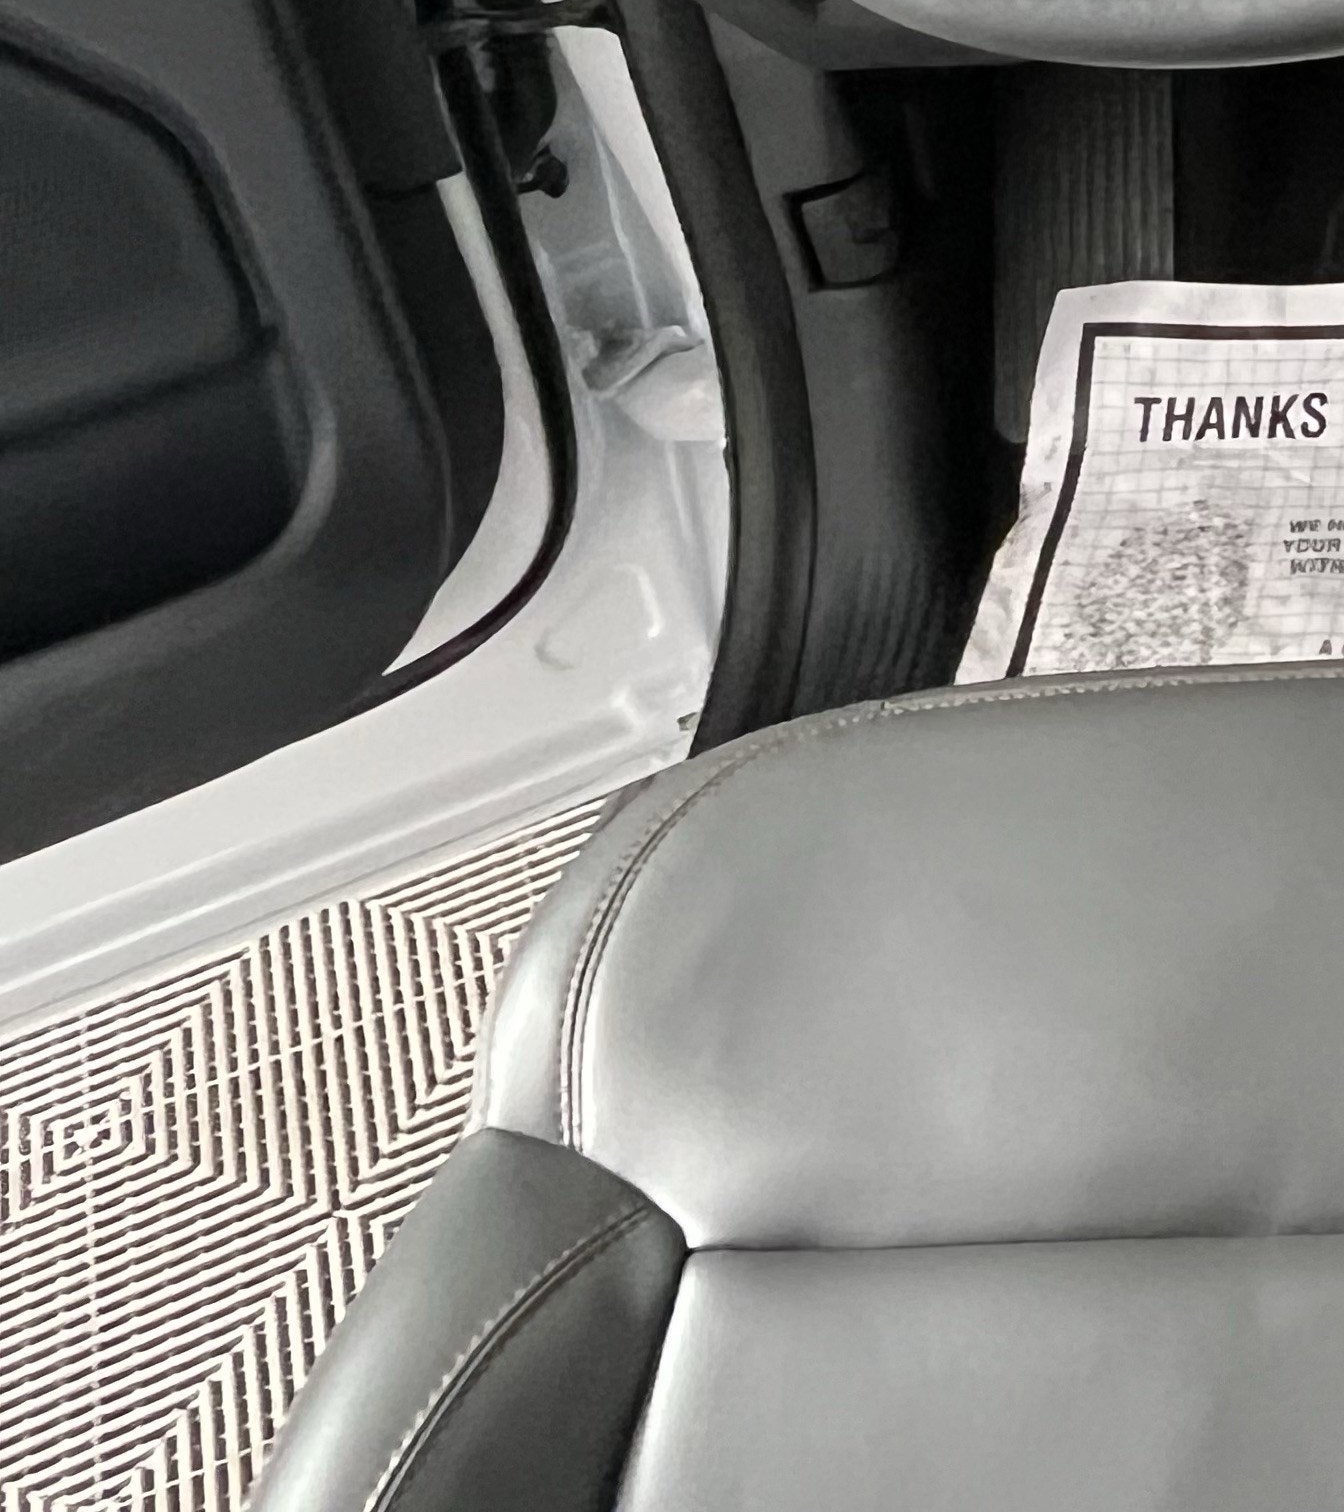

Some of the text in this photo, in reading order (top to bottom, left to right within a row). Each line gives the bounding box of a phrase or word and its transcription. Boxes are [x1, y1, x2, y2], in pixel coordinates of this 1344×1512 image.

[1133, 392, 1328, 443] THANKS
[1289, 518, 1322, 534] WE
[1282, 537, 1341, 553] YOUR
